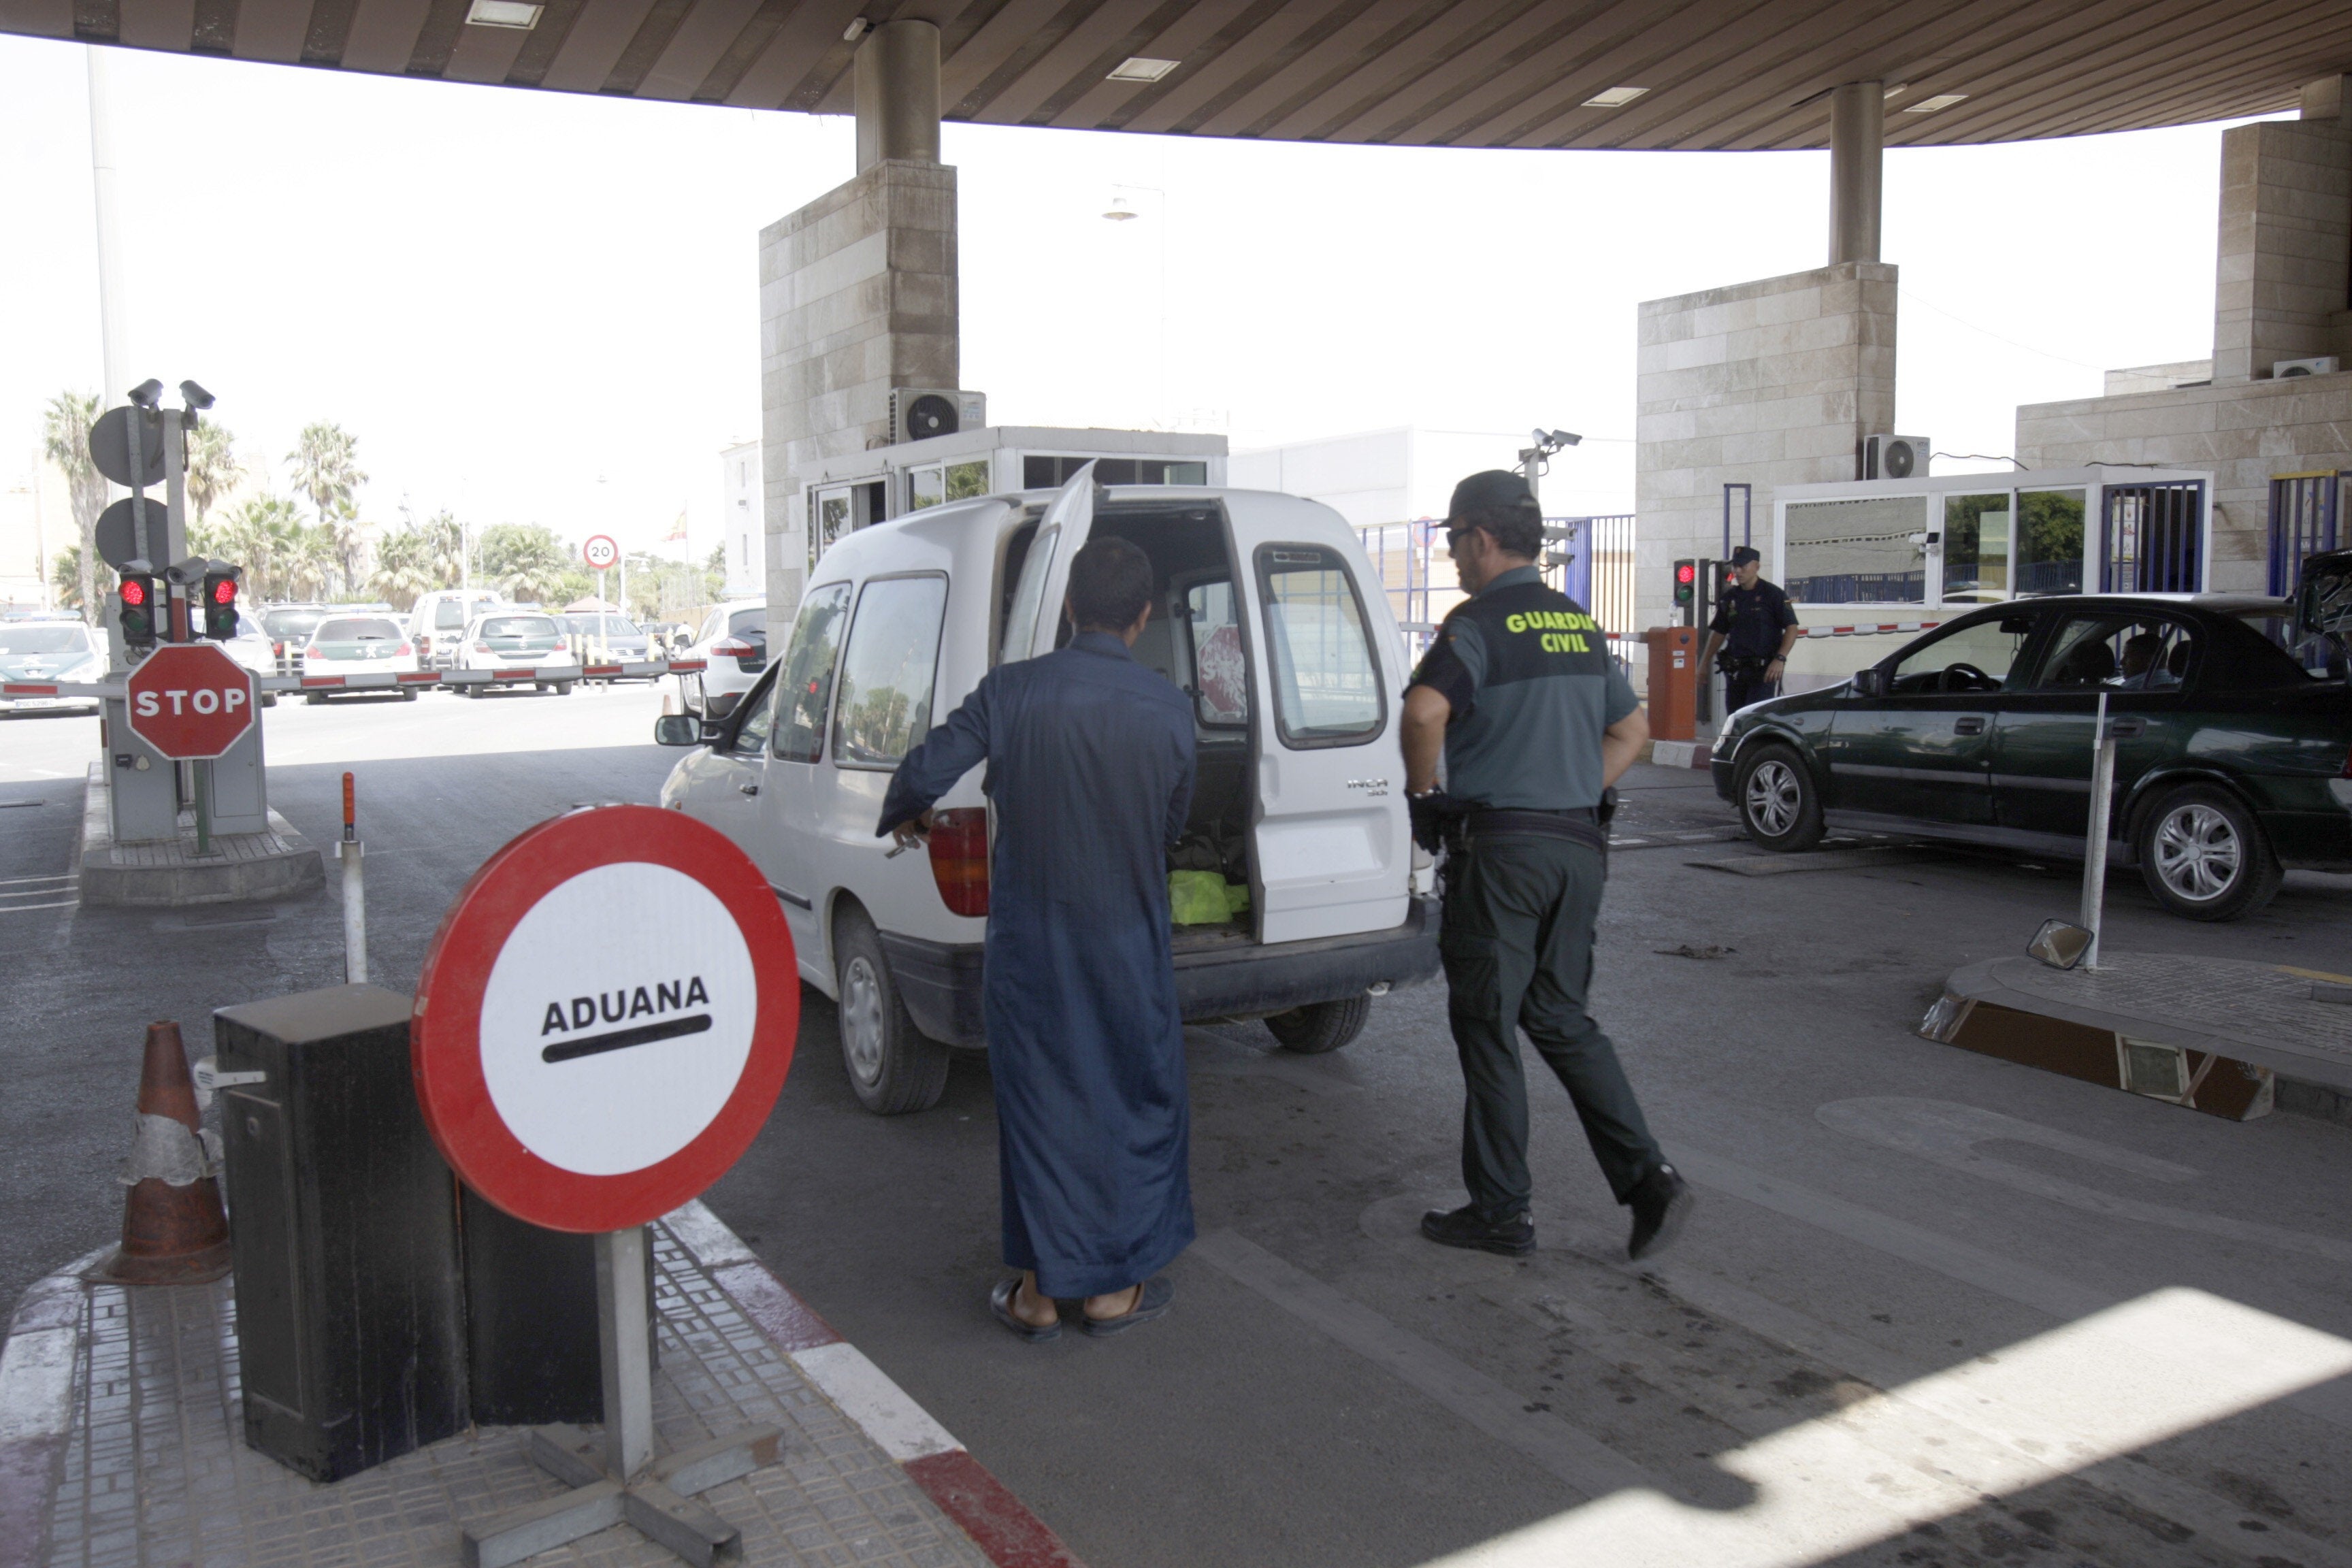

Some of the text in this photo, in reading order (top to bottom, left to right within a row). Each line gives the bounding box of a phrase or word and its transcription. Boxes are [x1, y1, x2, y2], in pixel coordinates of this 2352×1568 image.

[591, 546, 610, 557] 20
[1541, 633, 1590, 652] CIVIL
[136, 688, 246, 717] STOP
[1347, 779, 1388, 788] INCA
[542, 976, 709, 1036] ADUANA
